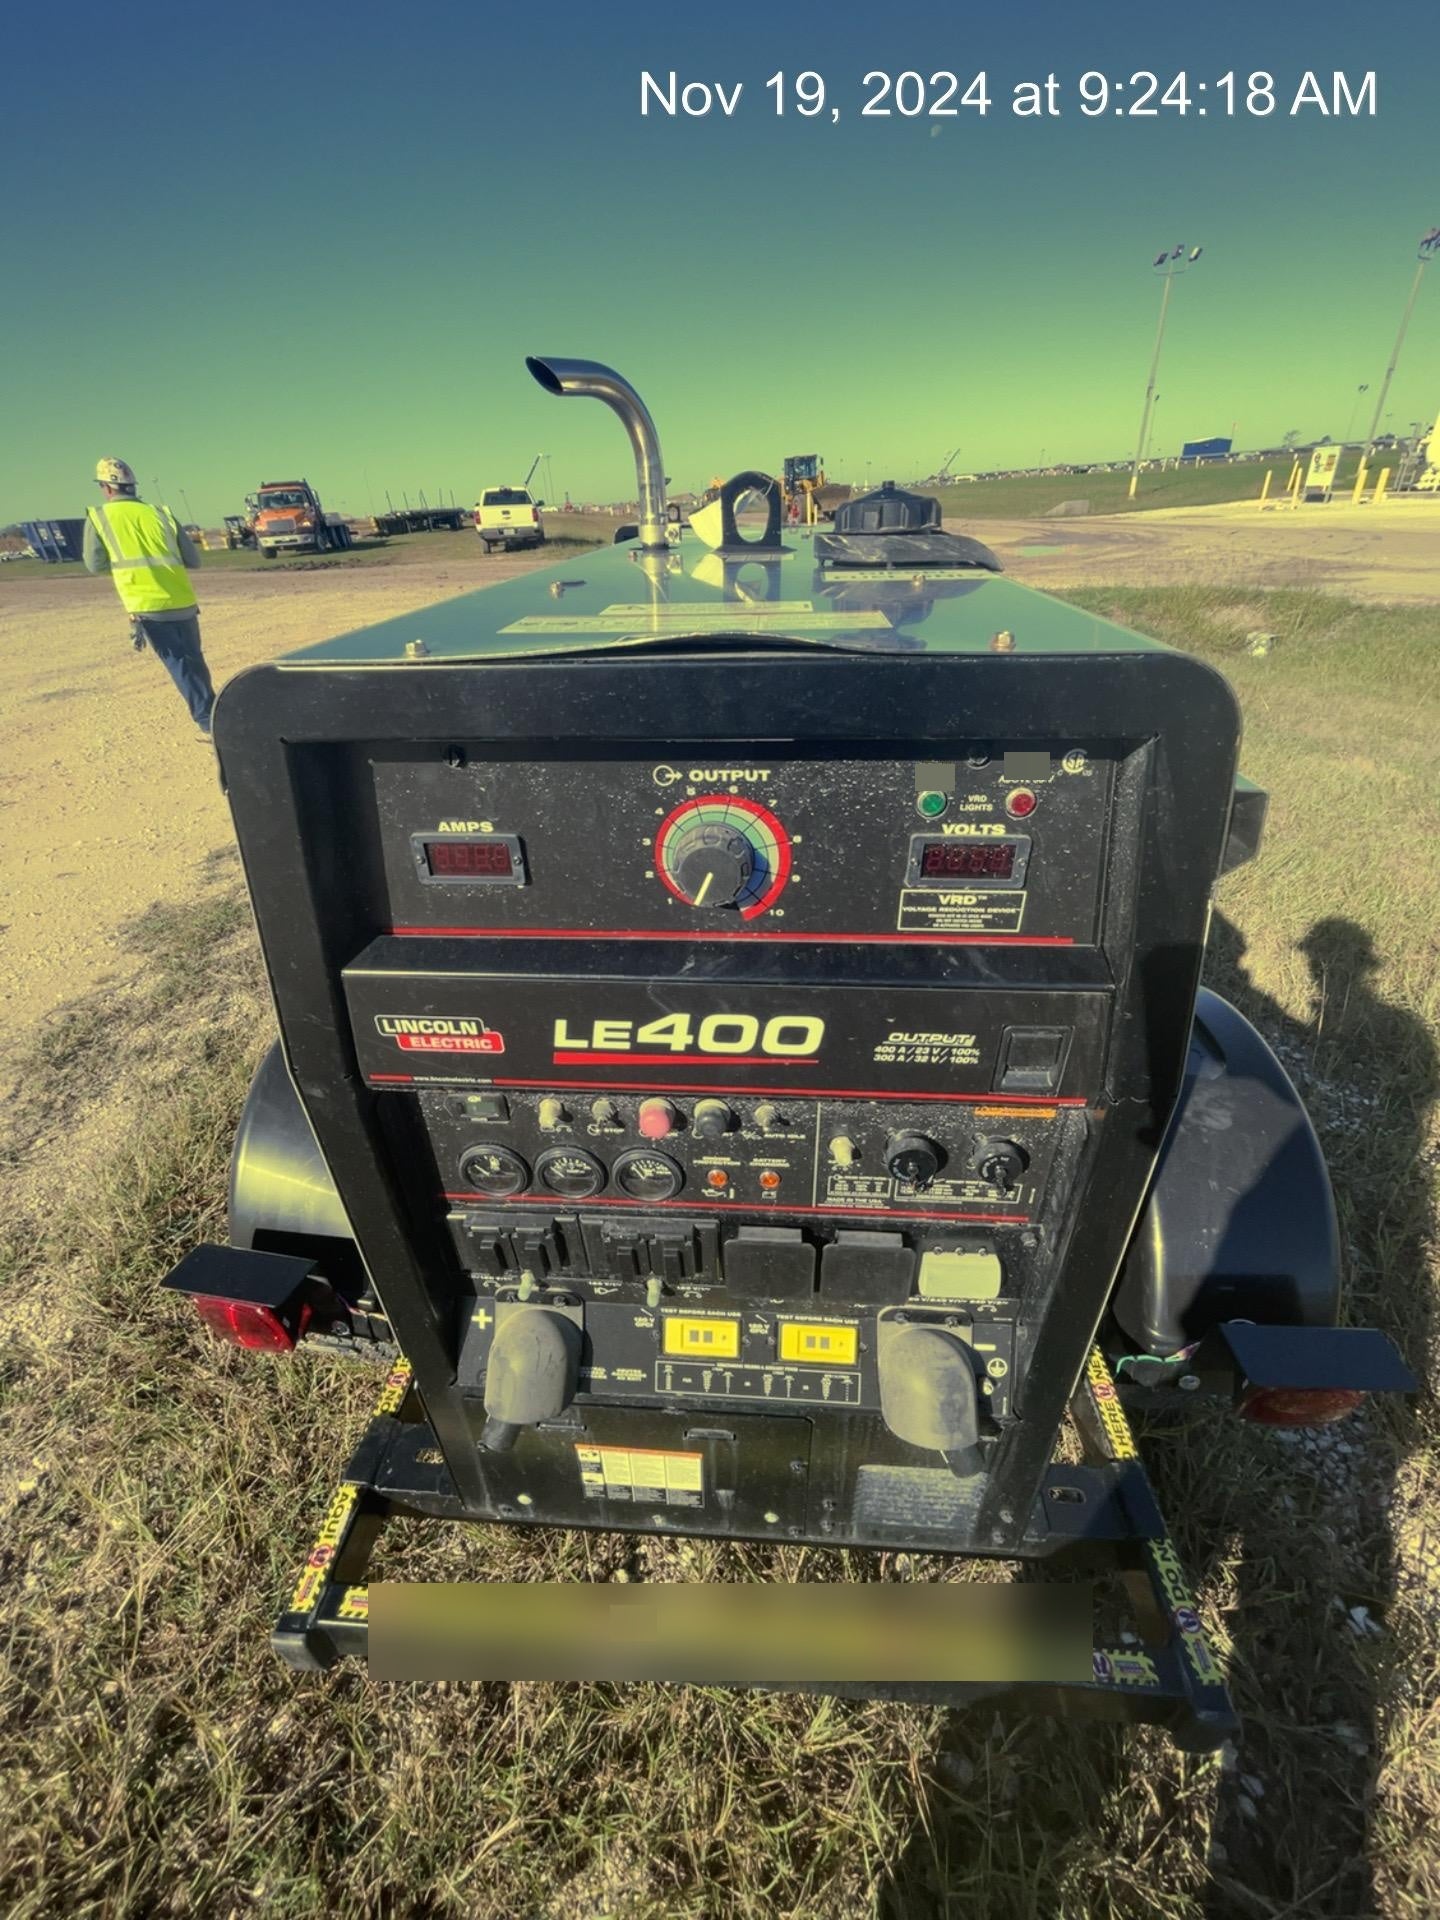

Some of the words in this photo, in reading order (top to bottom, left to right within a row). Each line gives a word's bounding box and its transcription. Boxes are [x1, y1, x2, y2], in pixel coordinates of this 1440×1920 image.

[688, 769, 771, 783] OUTPUT
[729, 784, 739, 795] 6
[768, 799, 778, 808] 7
[968, 794, 988, 803] VRD
[654, 807, 665, 816] 4
[959, 803, 994, 812] LIGHTS
[438, 821, 495, 833] AMPS
[941, 823, 1007, 836] VOLTS
[642, 837, 652, 847] 3
[644, 870, 655, 879] 2
[791, 874, 802, 884] 9
[667, 897, 674, 906] 1
[768, 908, 786, 918] 10
[902, 905, 938, 913] VOLTAGE
[938, 906, 986, 914] REDUCTION
[381, 1018, 479, 1036] LINCOLN
[553, 1012, 826, 1056] LE400
[410, 1035, 494, 1050] ELECTRIC
[873, 1045, 897, 1054] 400
[951, 1047, 980, 1056] 100%
[872, 1053, 896, 1062] 300
[950, 1056, 979, 1064] 100%
[412, 1075, 492, 1084] www.lincolnelectric.com
[1104, 1401, 1129, 1446] HERE
[323, 1491, 349, 1539] AQUI
[1165, 1567, 1185, 1602] DO
